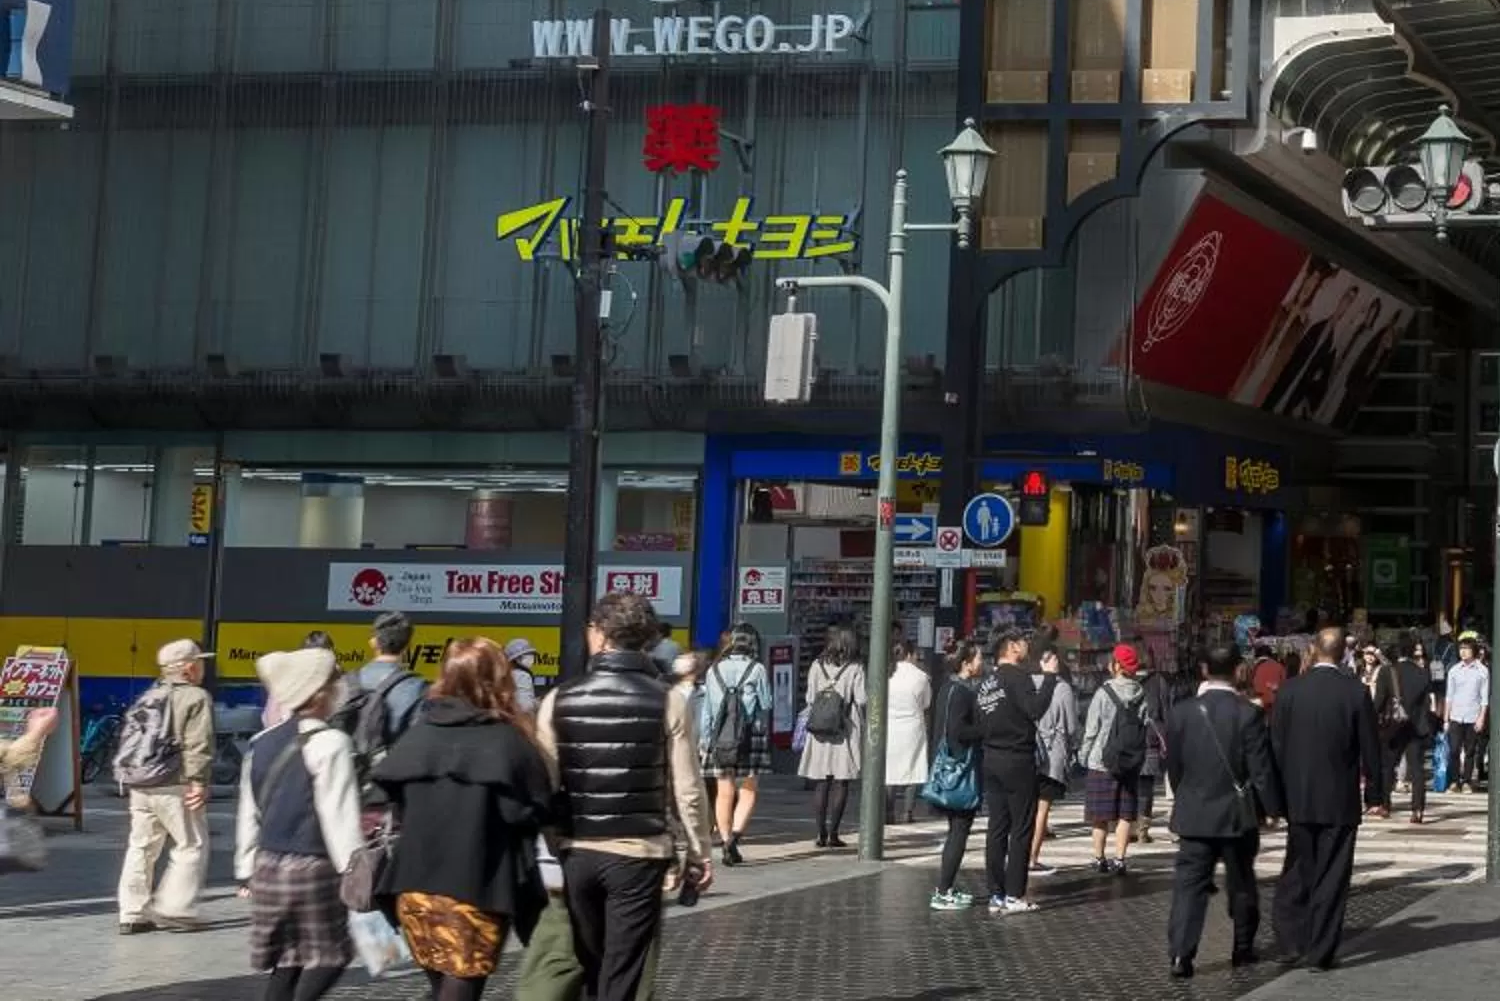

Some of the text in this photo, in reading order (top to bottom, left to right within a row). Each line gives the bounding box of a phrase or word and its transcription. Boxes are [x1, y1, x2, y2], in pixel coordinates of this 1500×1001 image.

[449, 570, 490, 594] Tax
[496, 570, 537, 595] Free
[612, 574, 654, 597] 免税
